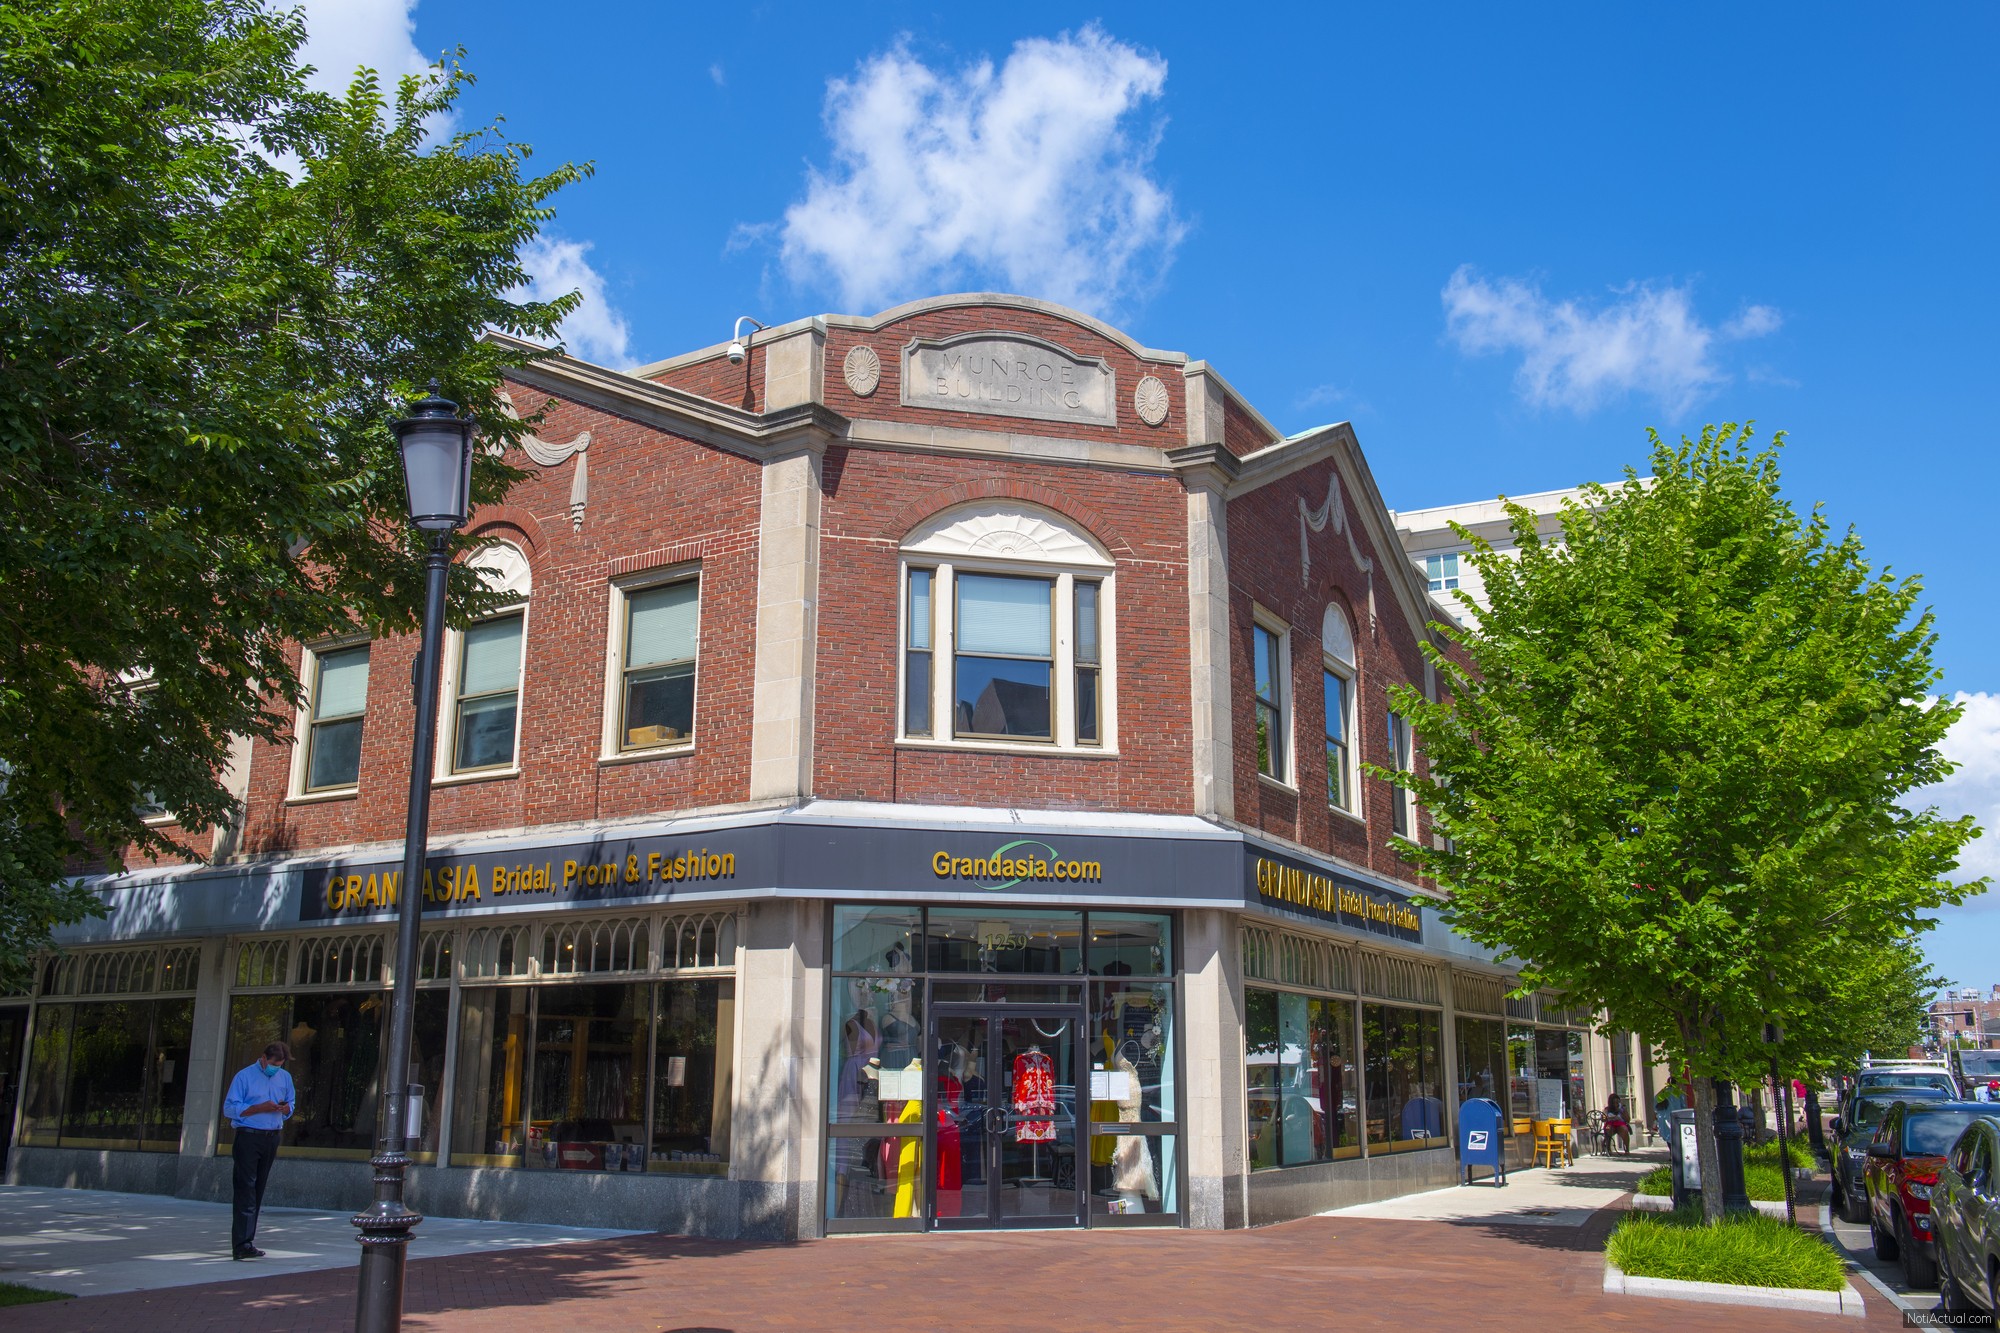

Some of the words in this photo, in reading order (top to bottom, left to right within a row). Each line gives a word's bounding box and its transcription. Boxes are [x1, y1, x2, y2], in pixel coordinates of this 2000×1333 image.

[943, 353, 1074, 385] MUNROE
[936, 377, 1081, 409] BUILDING
[327, 864, 481, 910] GRANASIA
[492, 862, 556, 893] Bridal,
[564, 859, 618, 888] Prom
[625, 854, 641, 883] &
[647, 848, 735, 881] Fashion
[932, 851, 1101, 879] Grandasia.com
[1257, 858, 1336, 913] GRANDASIA
[985, 933, 1028, 951] 1259
